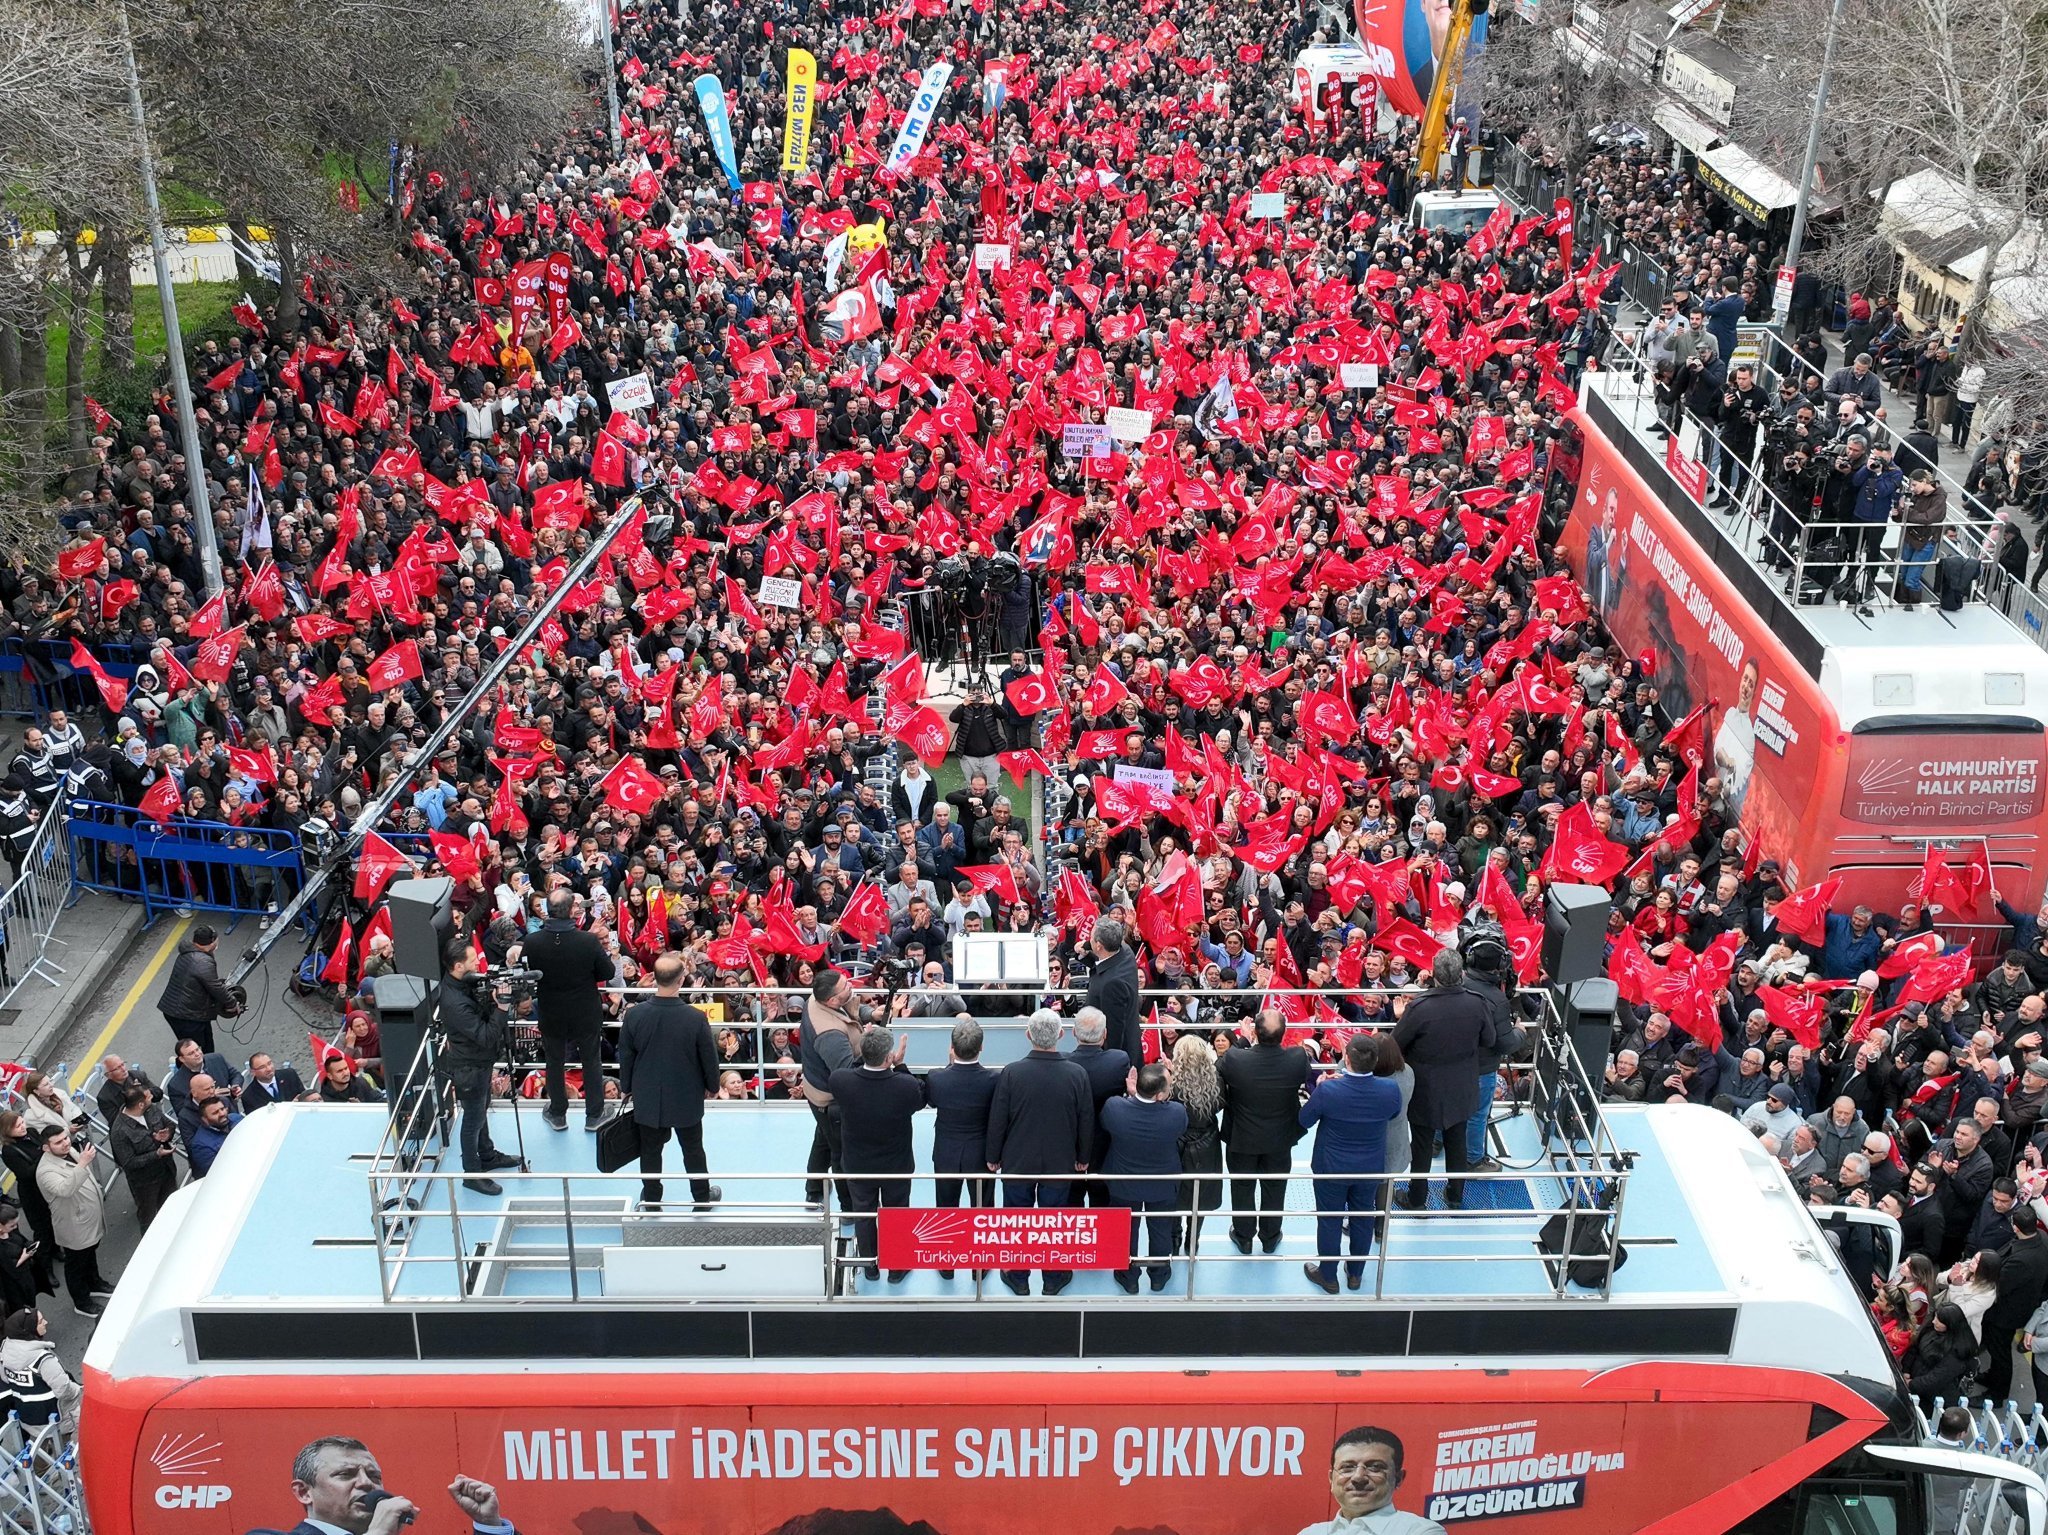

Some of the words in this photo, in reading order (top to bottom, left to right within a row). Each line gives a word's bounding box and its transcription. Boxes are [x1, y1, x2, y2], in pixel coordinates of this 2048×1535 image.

[1368, 43, 1395, 79] HP
[1730, 186, 1753, 212] Kahve
[425, 494, 441, 506] CHP
[72, 560, 95, 568] CHP
[630, 557, 643, 576] CHP
[1099, 580, 1119, 588] CHP
[887, 717, 899, 731] CH
[497, 737, 522, 748] CHP
[1919, 756, 2038, 777] CUMHURİYET
[1916, 780, 1964, 794] HALK
[1968, 774, 2037, 794] PARTİSİ
[1105, 801, 1130, 813] CHP
[1857, 801, 1935, 819] Türkiye'nin
[1939, 801, 1984, 816] Birinci
[1987, 800, 2033, 815] Partisi
[1571, 859, 1594, 873] CHP
[1901, 904, 1943, 917] CP
[1272, 1002, 1285, 1013] CH
[973, 1211, 1097, 1229] CUMHURİYET
[973, 1231, 1023, 1245] HALK
[1027, 1228, 1097, 1245] PARTİSİ
[914, 1248, 996, 1265] Türkiye'nin
[999, 1248, 1046, 1264] Birinci
[1050, 1248, 1097, 1264] Partisi
[1112, 1424, 1305, 1487] ÇIKIYOR
[1436, 1432, 1537, 1466] EKREM
[155, 1485, 232, 1509] CHP
[1428, 1481, 1579, 1522] ÖZGÜRLÜK
